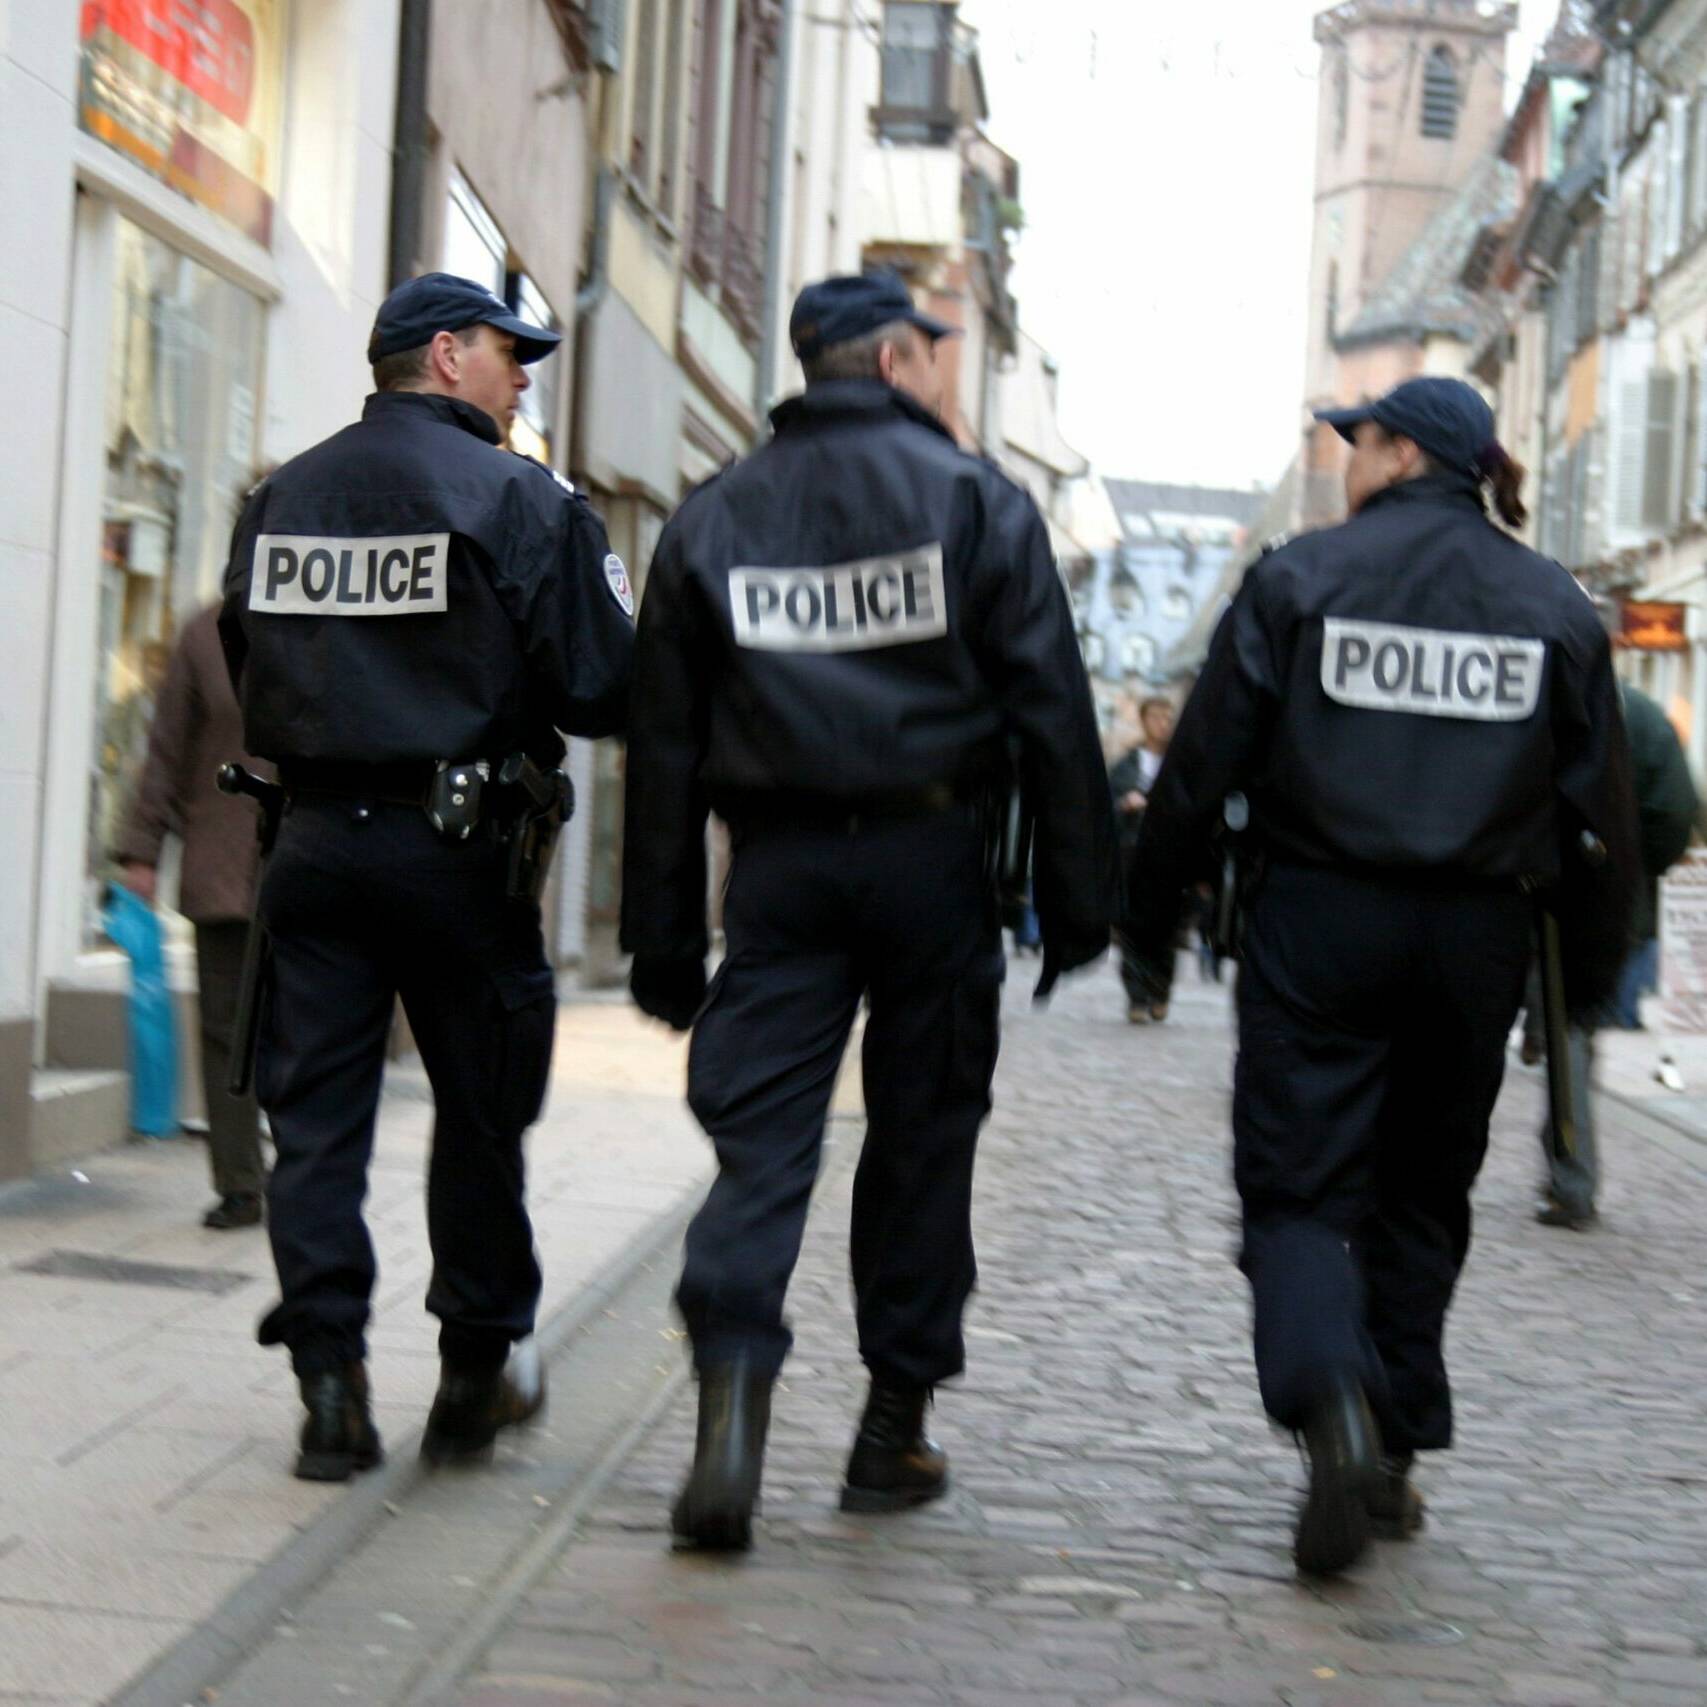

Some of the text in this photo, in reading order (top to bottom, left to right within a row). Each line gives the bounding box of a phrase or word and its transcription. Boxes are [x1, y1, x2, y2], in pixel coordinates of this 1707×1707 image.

[265, 545, 436, 603] POLICE
[745, 560, 935, 636] POLICE
[1335, 636, 1527, 703] POLICE
